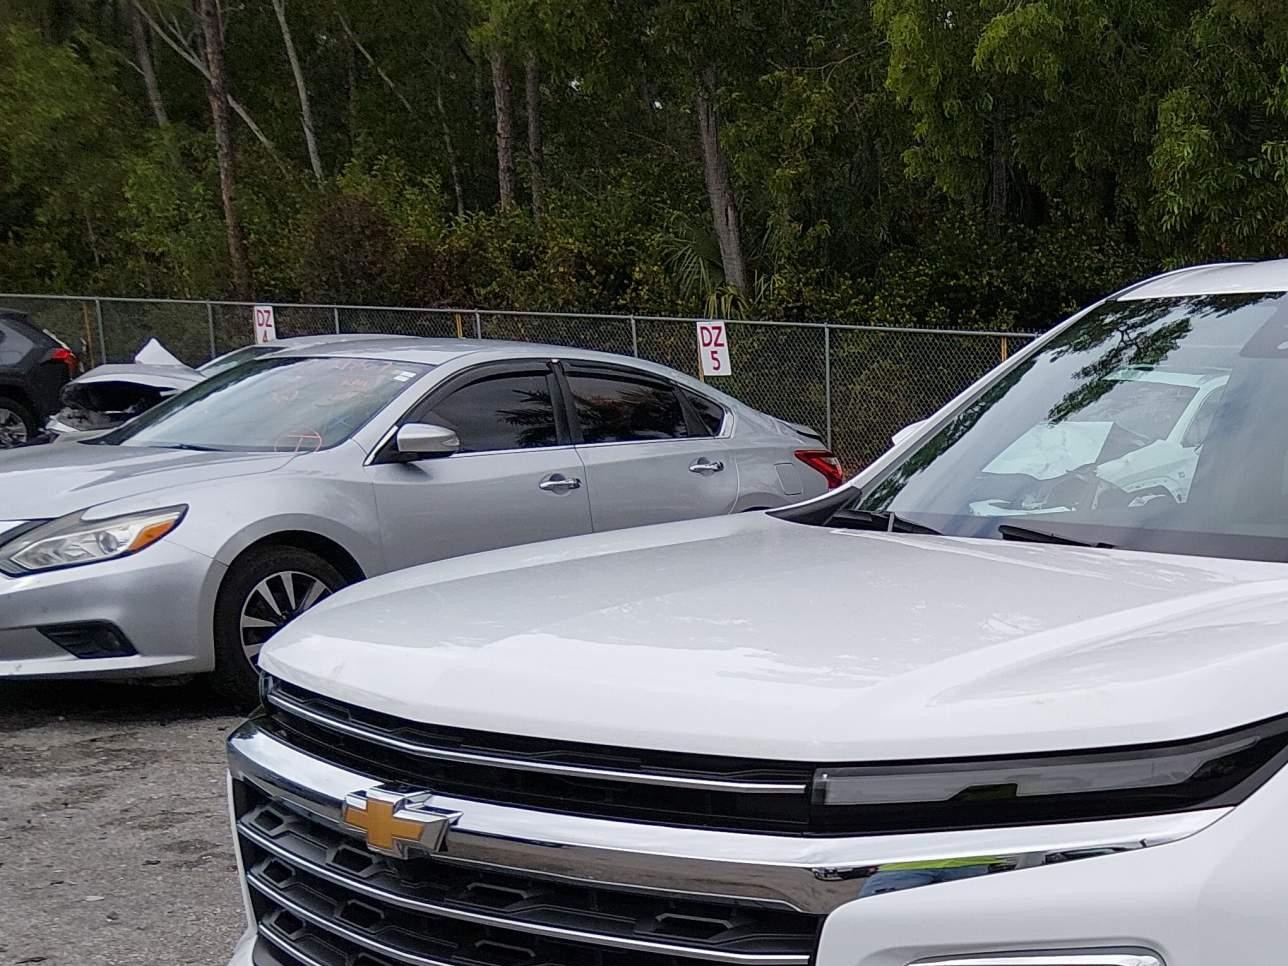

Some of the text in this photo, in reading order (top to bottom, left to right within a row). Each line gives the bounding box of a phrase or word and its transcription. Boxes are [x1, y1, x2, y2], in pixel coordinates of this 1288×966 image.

[256, 309, 272, 327] DZ
[700, 325, 725, 347] DZ
[710, 350, 721, 370] 5
